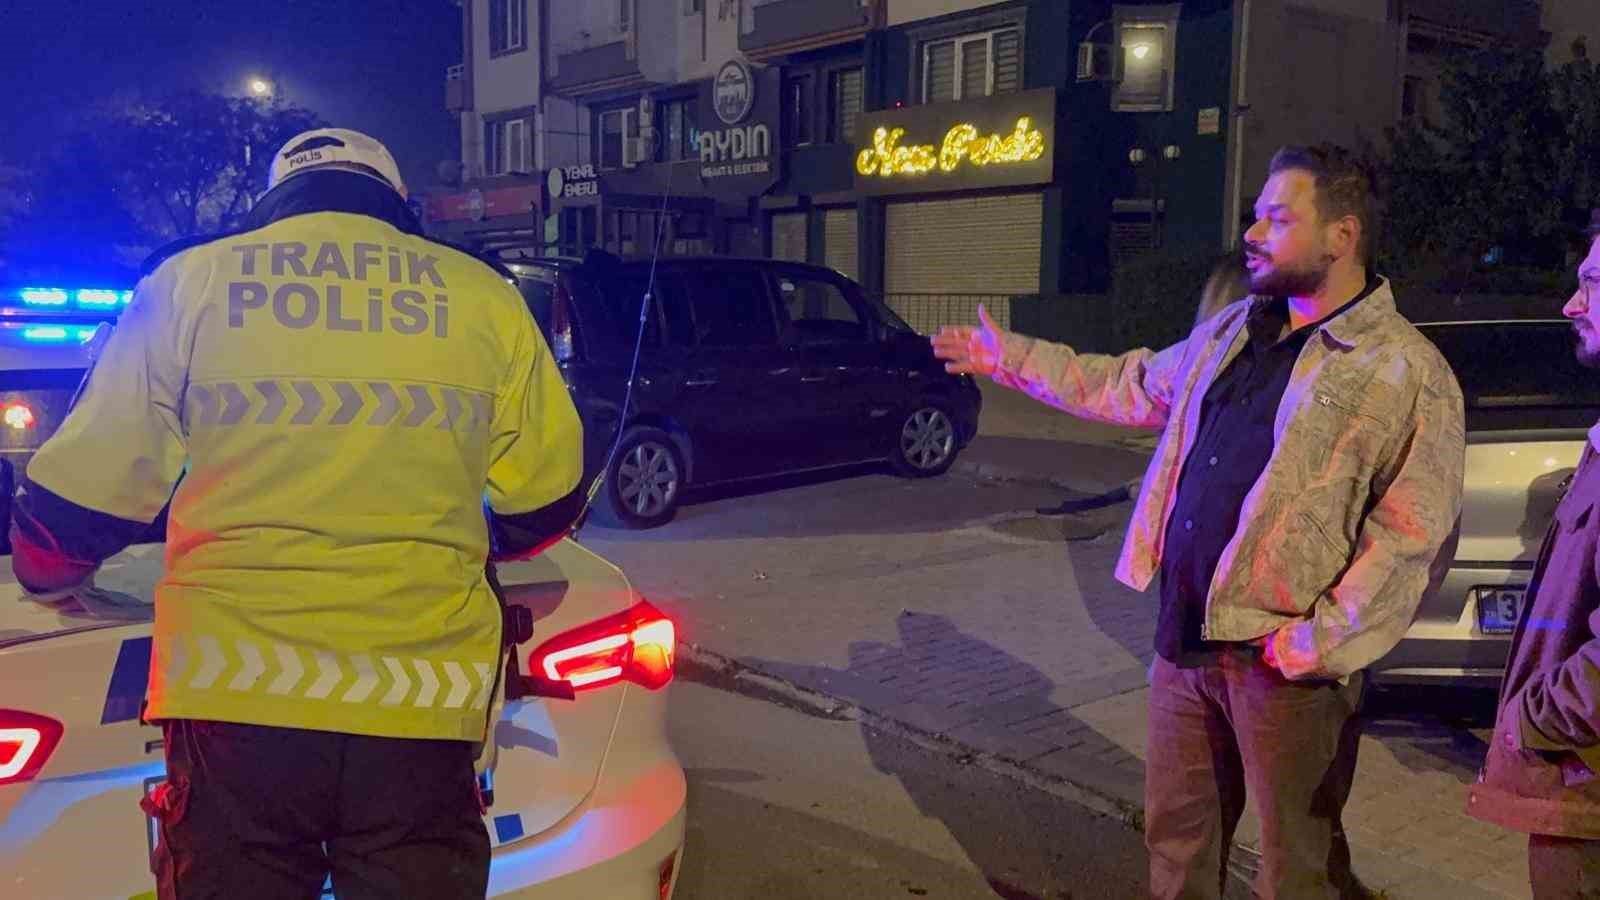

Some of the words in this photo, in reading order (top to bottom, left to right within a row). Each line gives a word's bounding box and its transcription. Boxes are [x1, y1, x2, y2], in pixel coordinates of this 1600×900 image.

[700, 124, 769, 162] AYDIN
[231, 240, 448, 289] TRAFİK
[227, 280, 449, 338] POLİSİ
